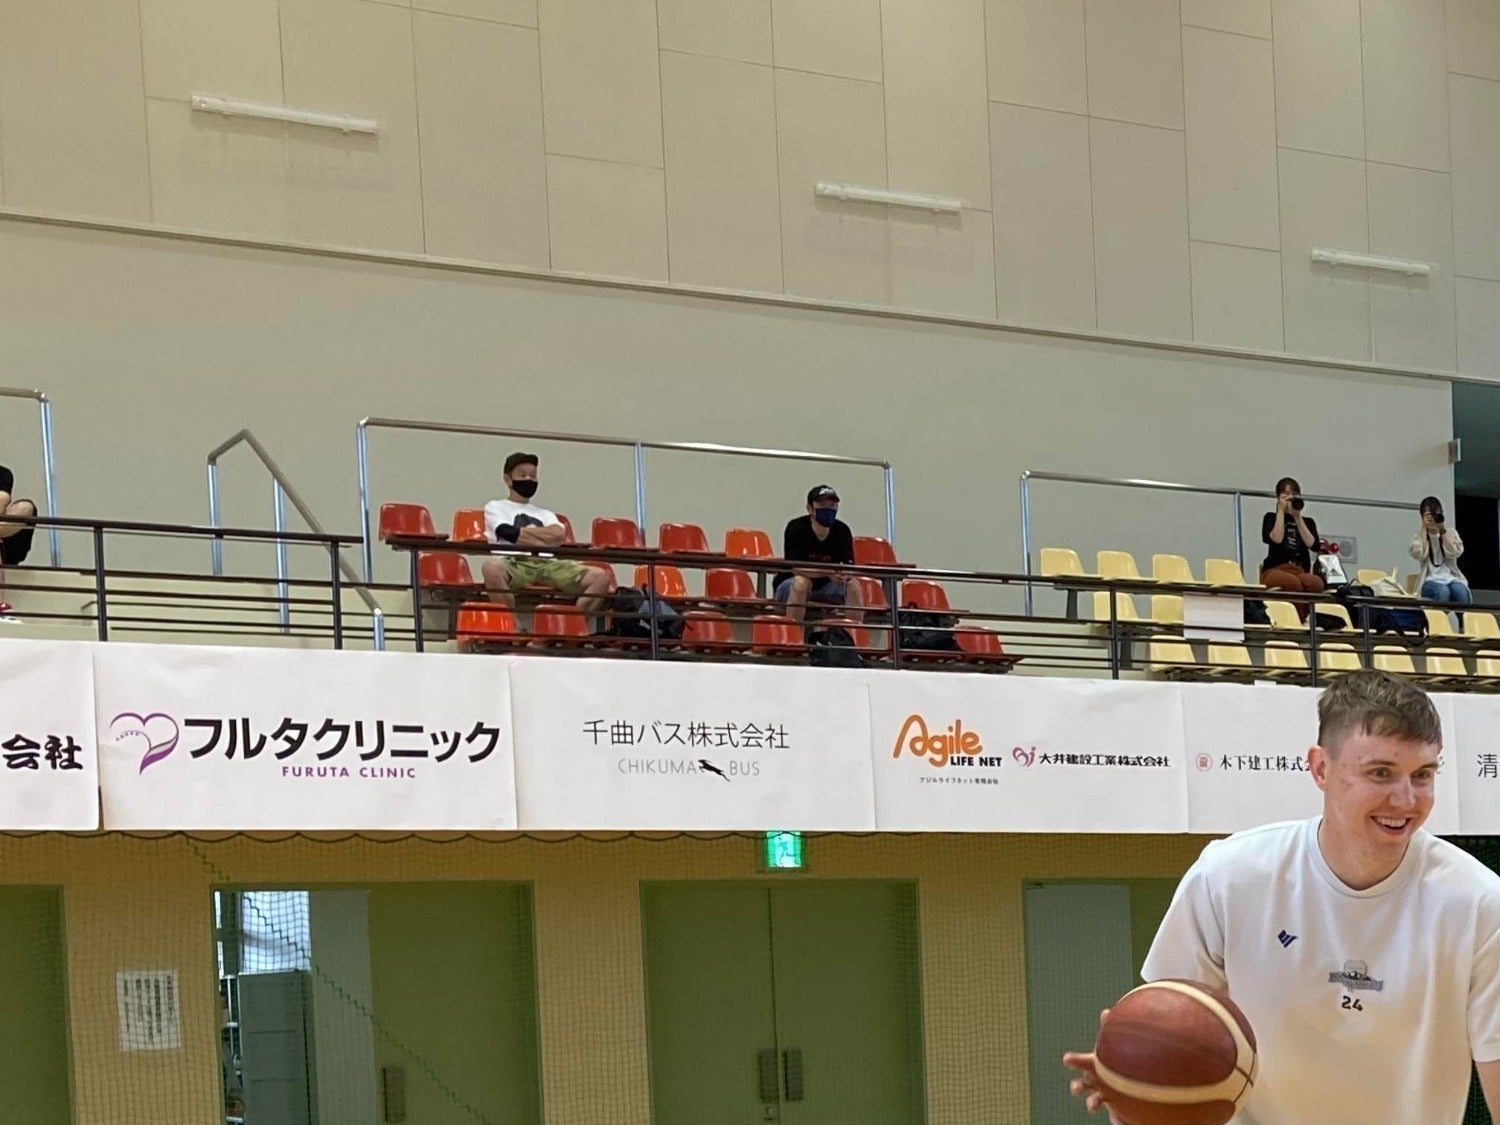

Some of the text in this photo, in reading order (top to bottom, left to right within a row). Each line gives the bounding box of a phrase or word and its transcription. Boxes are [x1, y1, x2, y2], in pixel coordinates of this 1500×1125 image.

[183, 716, 500, 763] フルタクリニック
[582, 719, 790, 749] 千曲バス株式会社
[893, 714, 983, 768] Agile
[1, 733, 83, 770] 会社
[950, 756, 974, 766] LIFE
[979, 756, 1002, 767] NET
[281, 765, 416, 778] FURUTA CLINIC
[618, 758, 760, 776] CHIKUMA BUS
[1341, 995, 1364, 1012] 24
